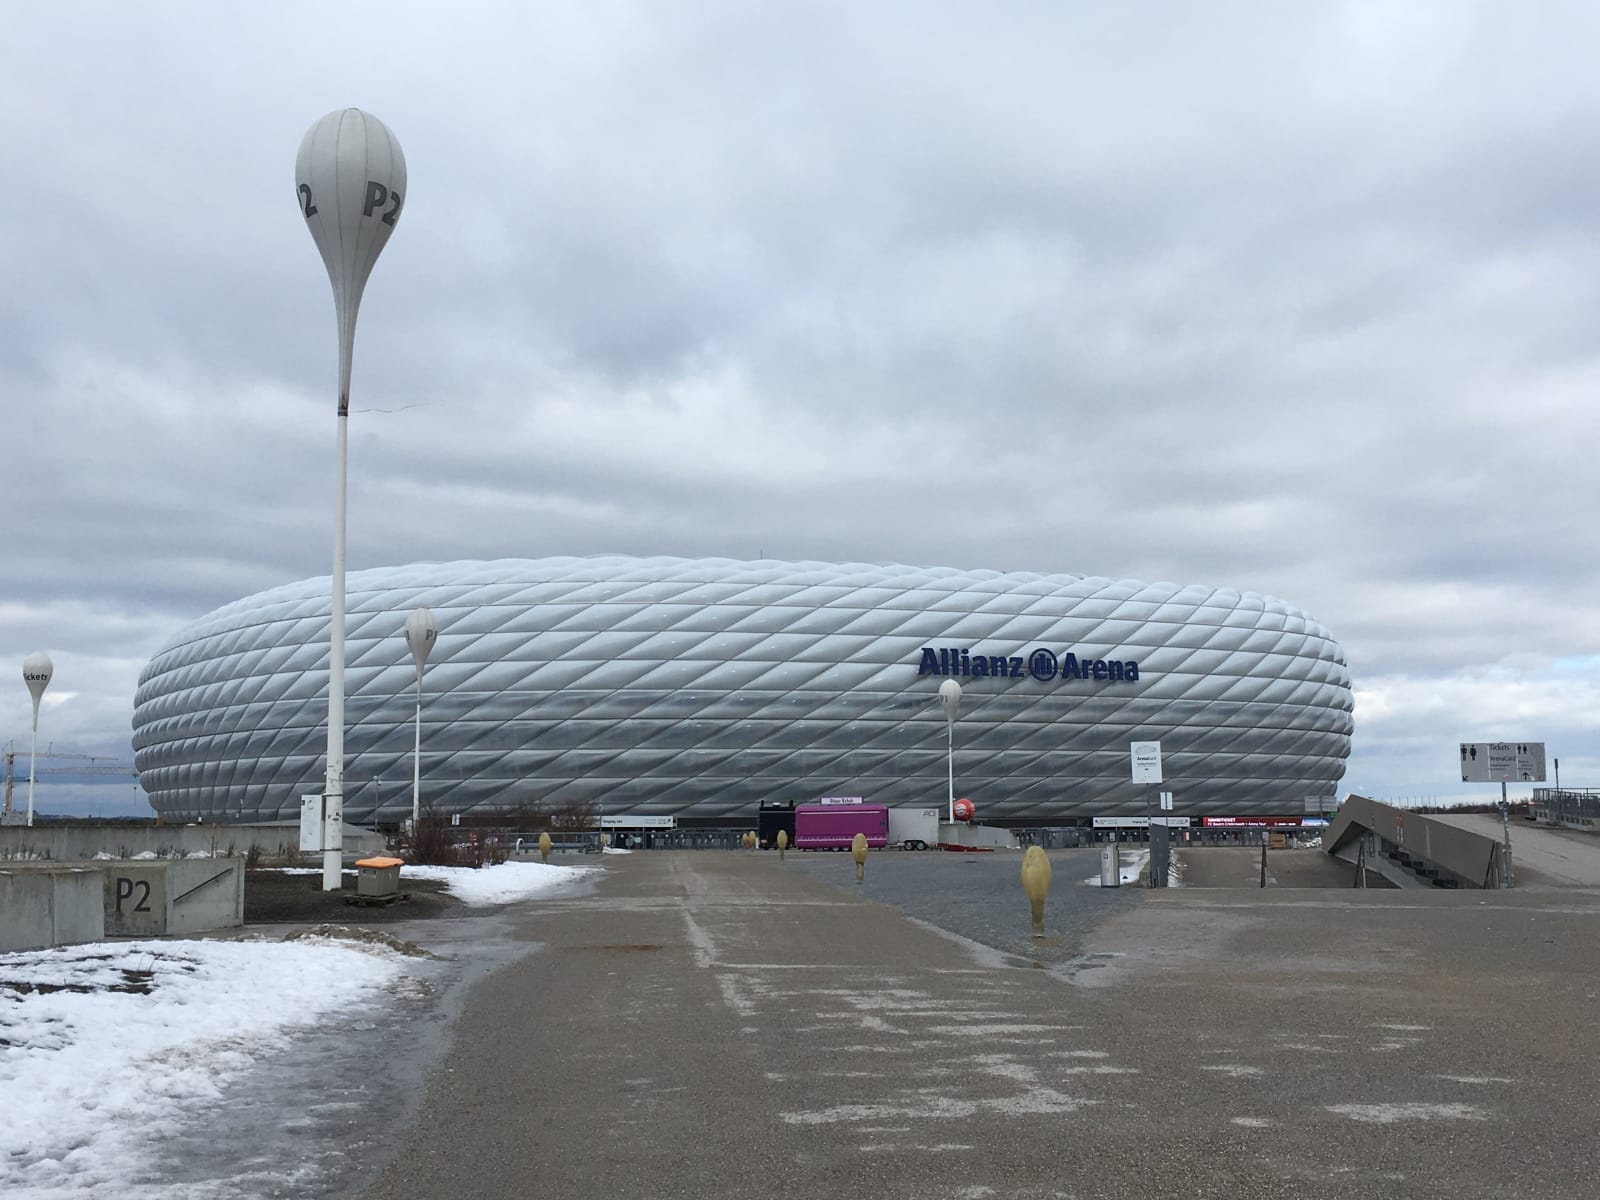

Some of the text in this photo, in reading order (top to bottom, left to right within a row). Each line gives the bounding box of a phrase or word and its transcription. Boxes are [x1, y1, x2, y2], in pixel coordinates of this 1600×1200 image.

[297, 184, 318, 218] 2
[363, 181, 401, 227] P2
[919, 648, 1139, 681] Allianz Arena
[1490, 743, 1510, 751] Tickets
[116, 877, 151, 912] P2
